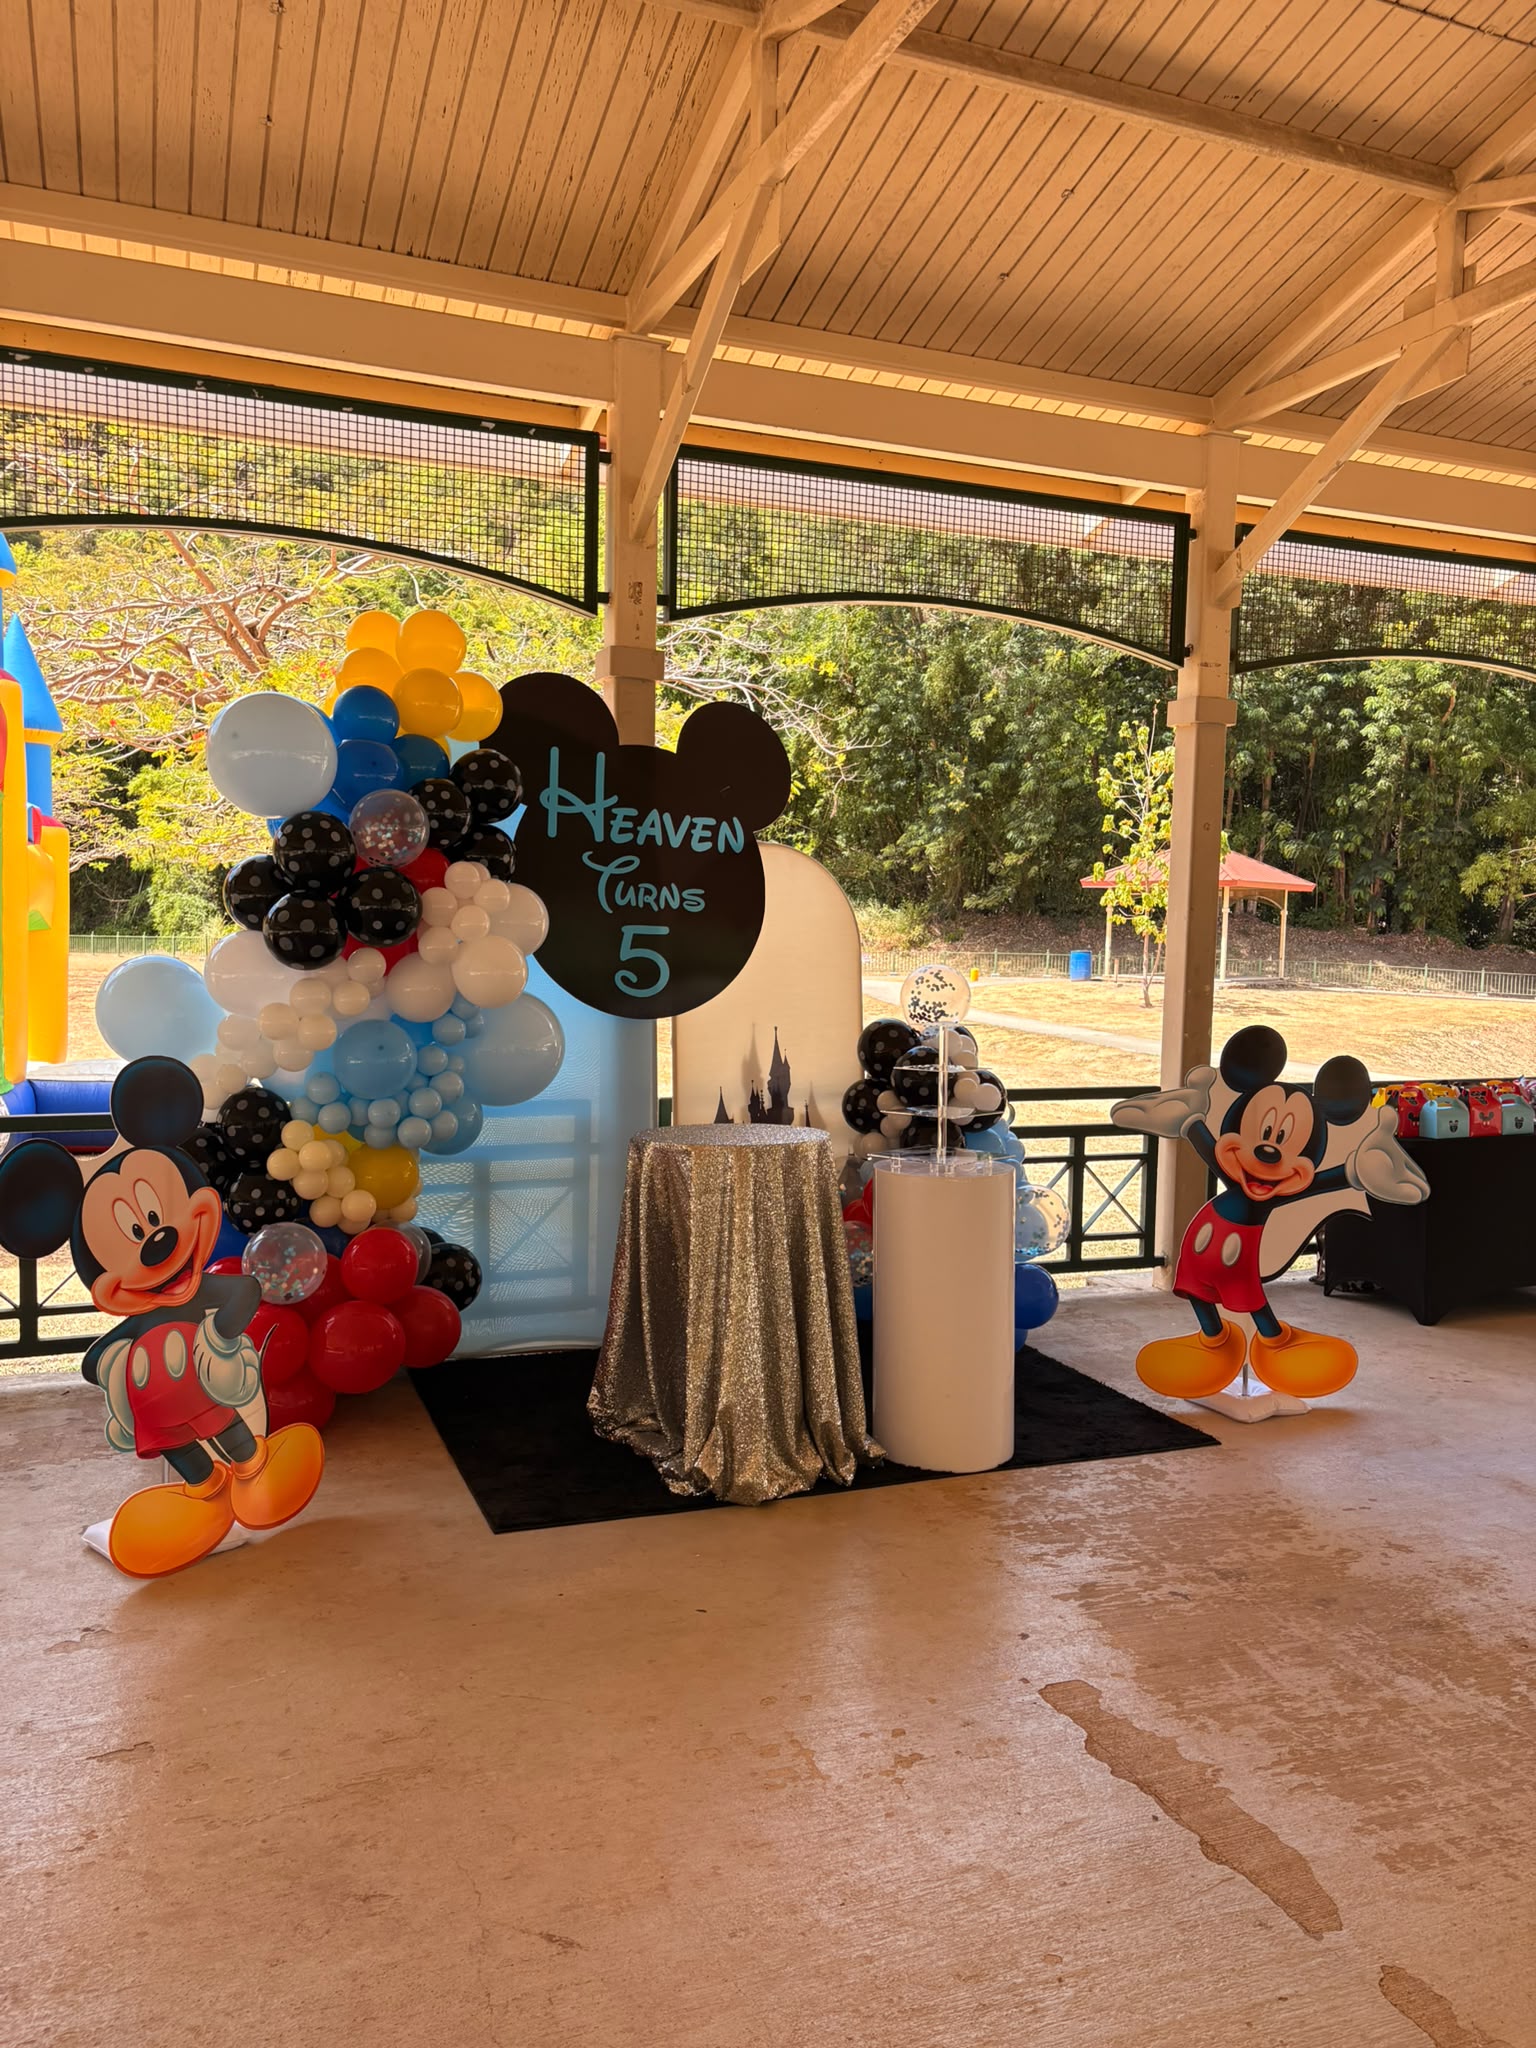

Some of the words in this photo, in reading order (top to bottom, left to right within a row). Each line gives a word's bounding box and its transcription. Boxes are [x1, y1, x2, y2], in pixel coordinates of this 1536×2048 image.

[539, 746, 745, 853] HEAVEN
[582, 851, 706, 914] TURNS
[614, 924, 670, 998] 5
